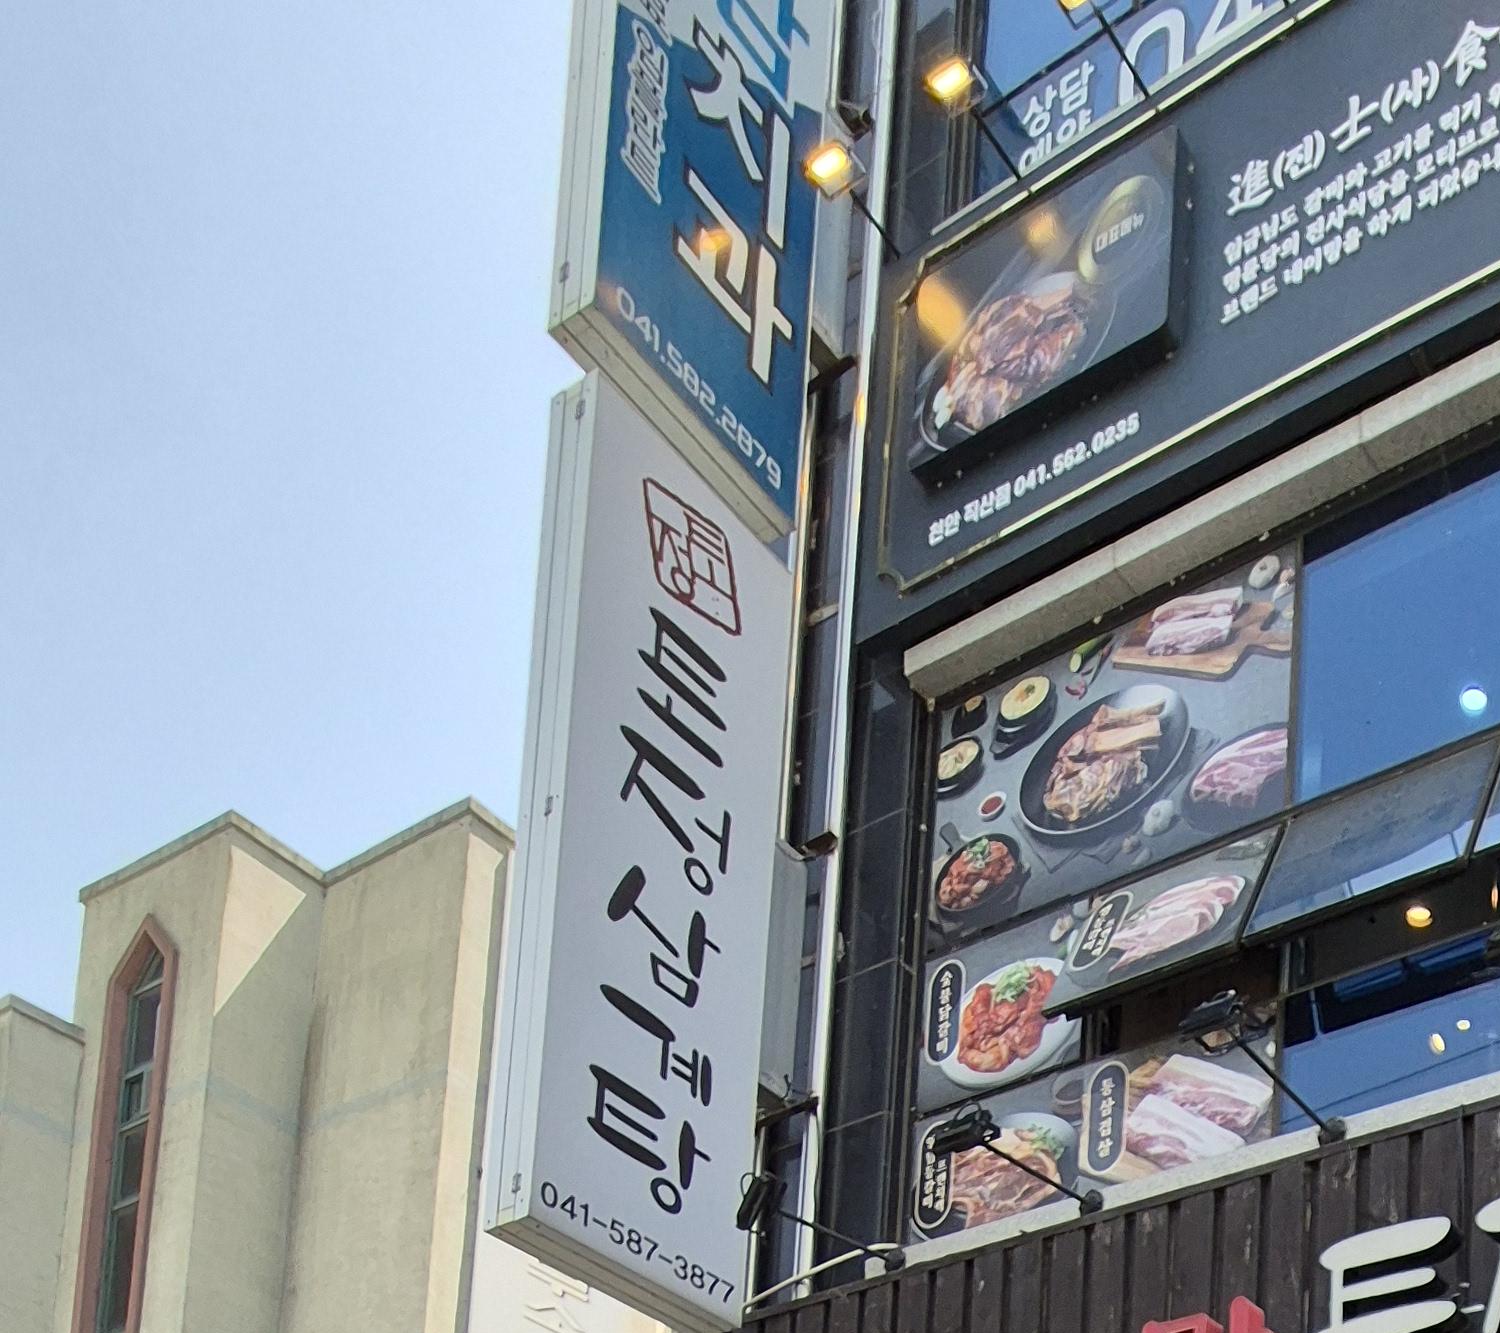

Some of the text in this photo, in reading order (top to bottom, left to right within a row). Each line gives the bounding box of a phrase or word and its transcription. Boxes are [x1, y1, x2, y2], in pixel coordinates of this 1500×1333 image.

[1021, 58, 1095, 138] 상담
[1371, 121, 1435, 178] 고기를
[1412, 114, 1500, 184] 모티브로
[674, 18, 795, 388] 치과
[616, 284, 783, 491] 041.582.2879
[928, 508, 962, 548] 천안
[1012, 411, 1141, 499] 041.562.0235
[585, 605, 734, 1217] 토정삼계탕
[538, 1180, 736, 1305] 041-587-3877
